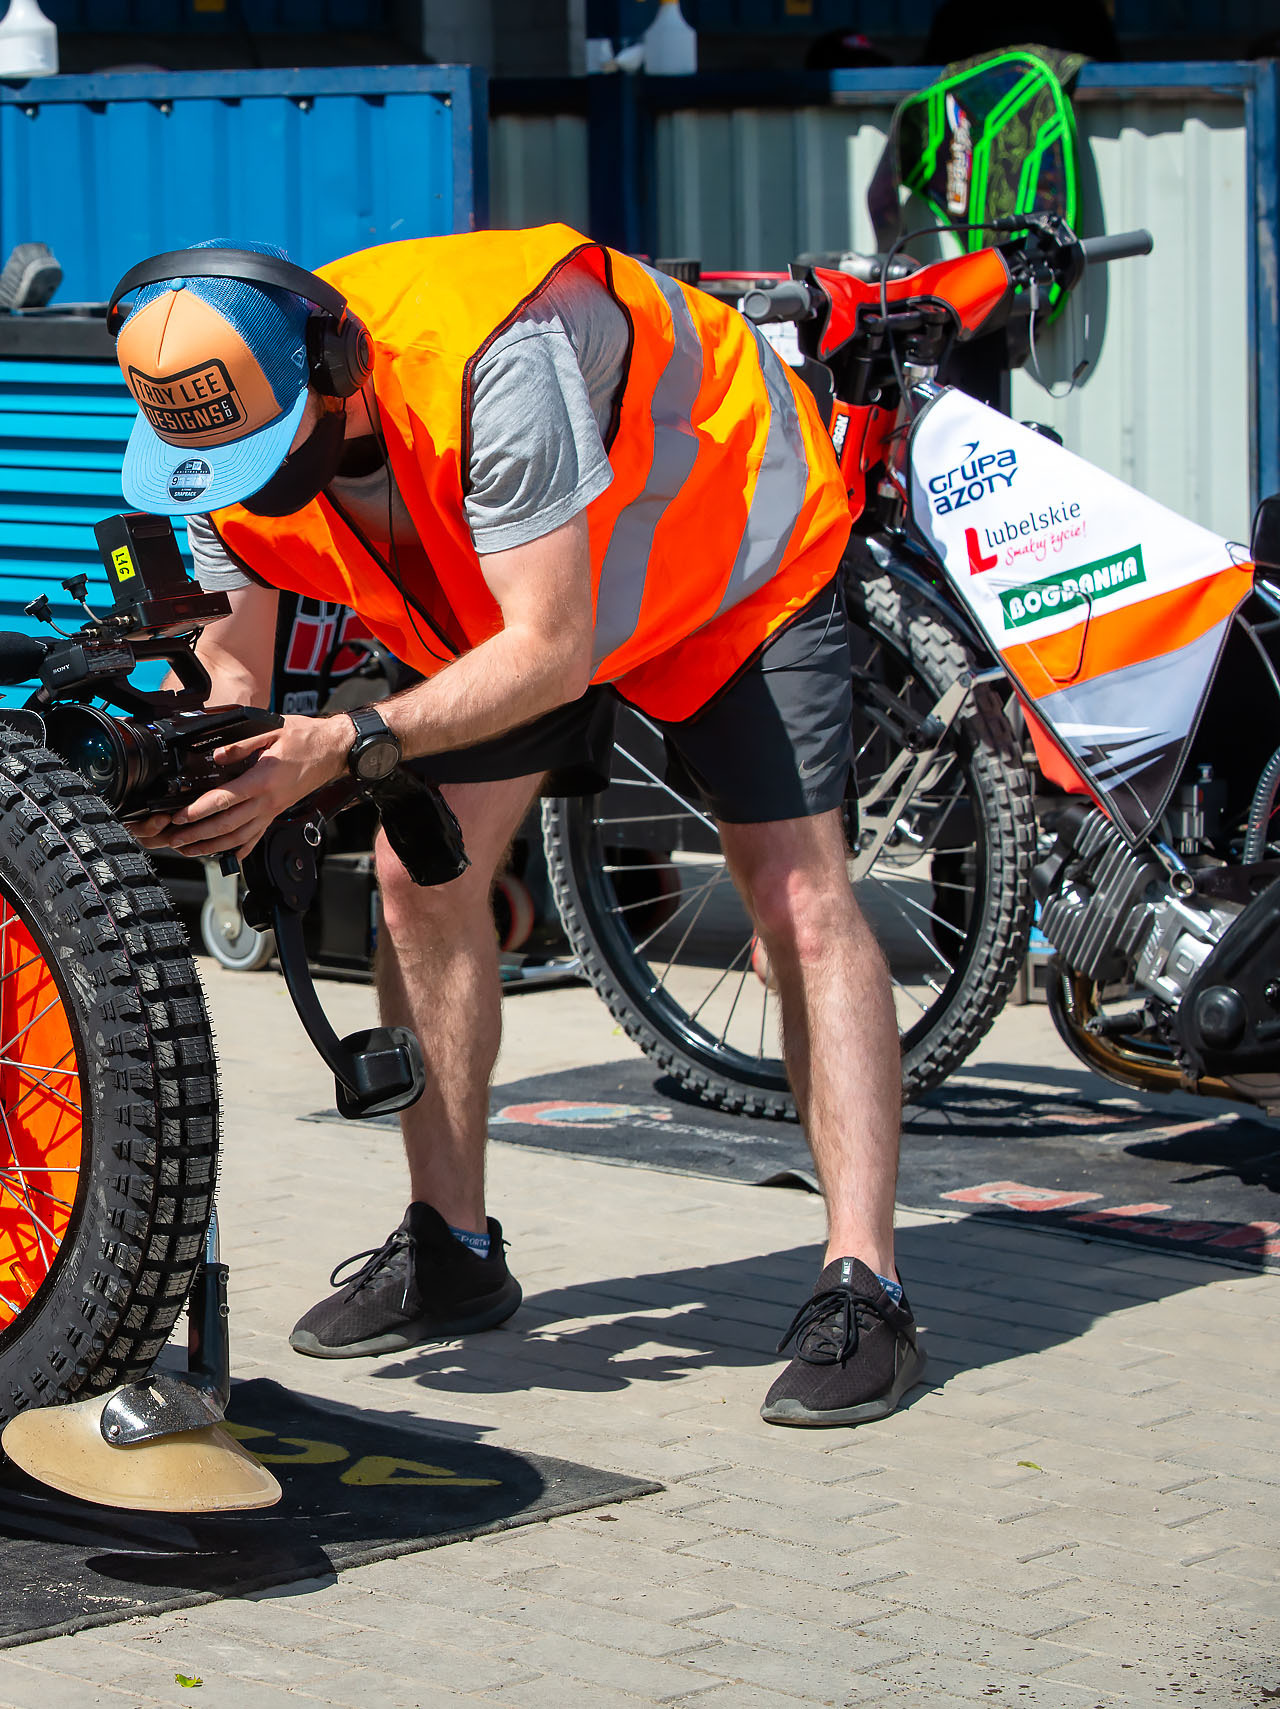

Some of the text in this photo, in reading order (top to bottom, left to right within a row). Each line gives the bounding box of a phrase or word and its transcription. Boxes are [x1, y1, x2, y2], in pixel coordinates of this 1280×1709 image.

[135, 372, 221, 405] TROY LEE
[145, 403, 224, 430] DESIGNS
[1008, 556, 1139, 620] BOGDANKA
[52, 663, 71, 675] SONY
